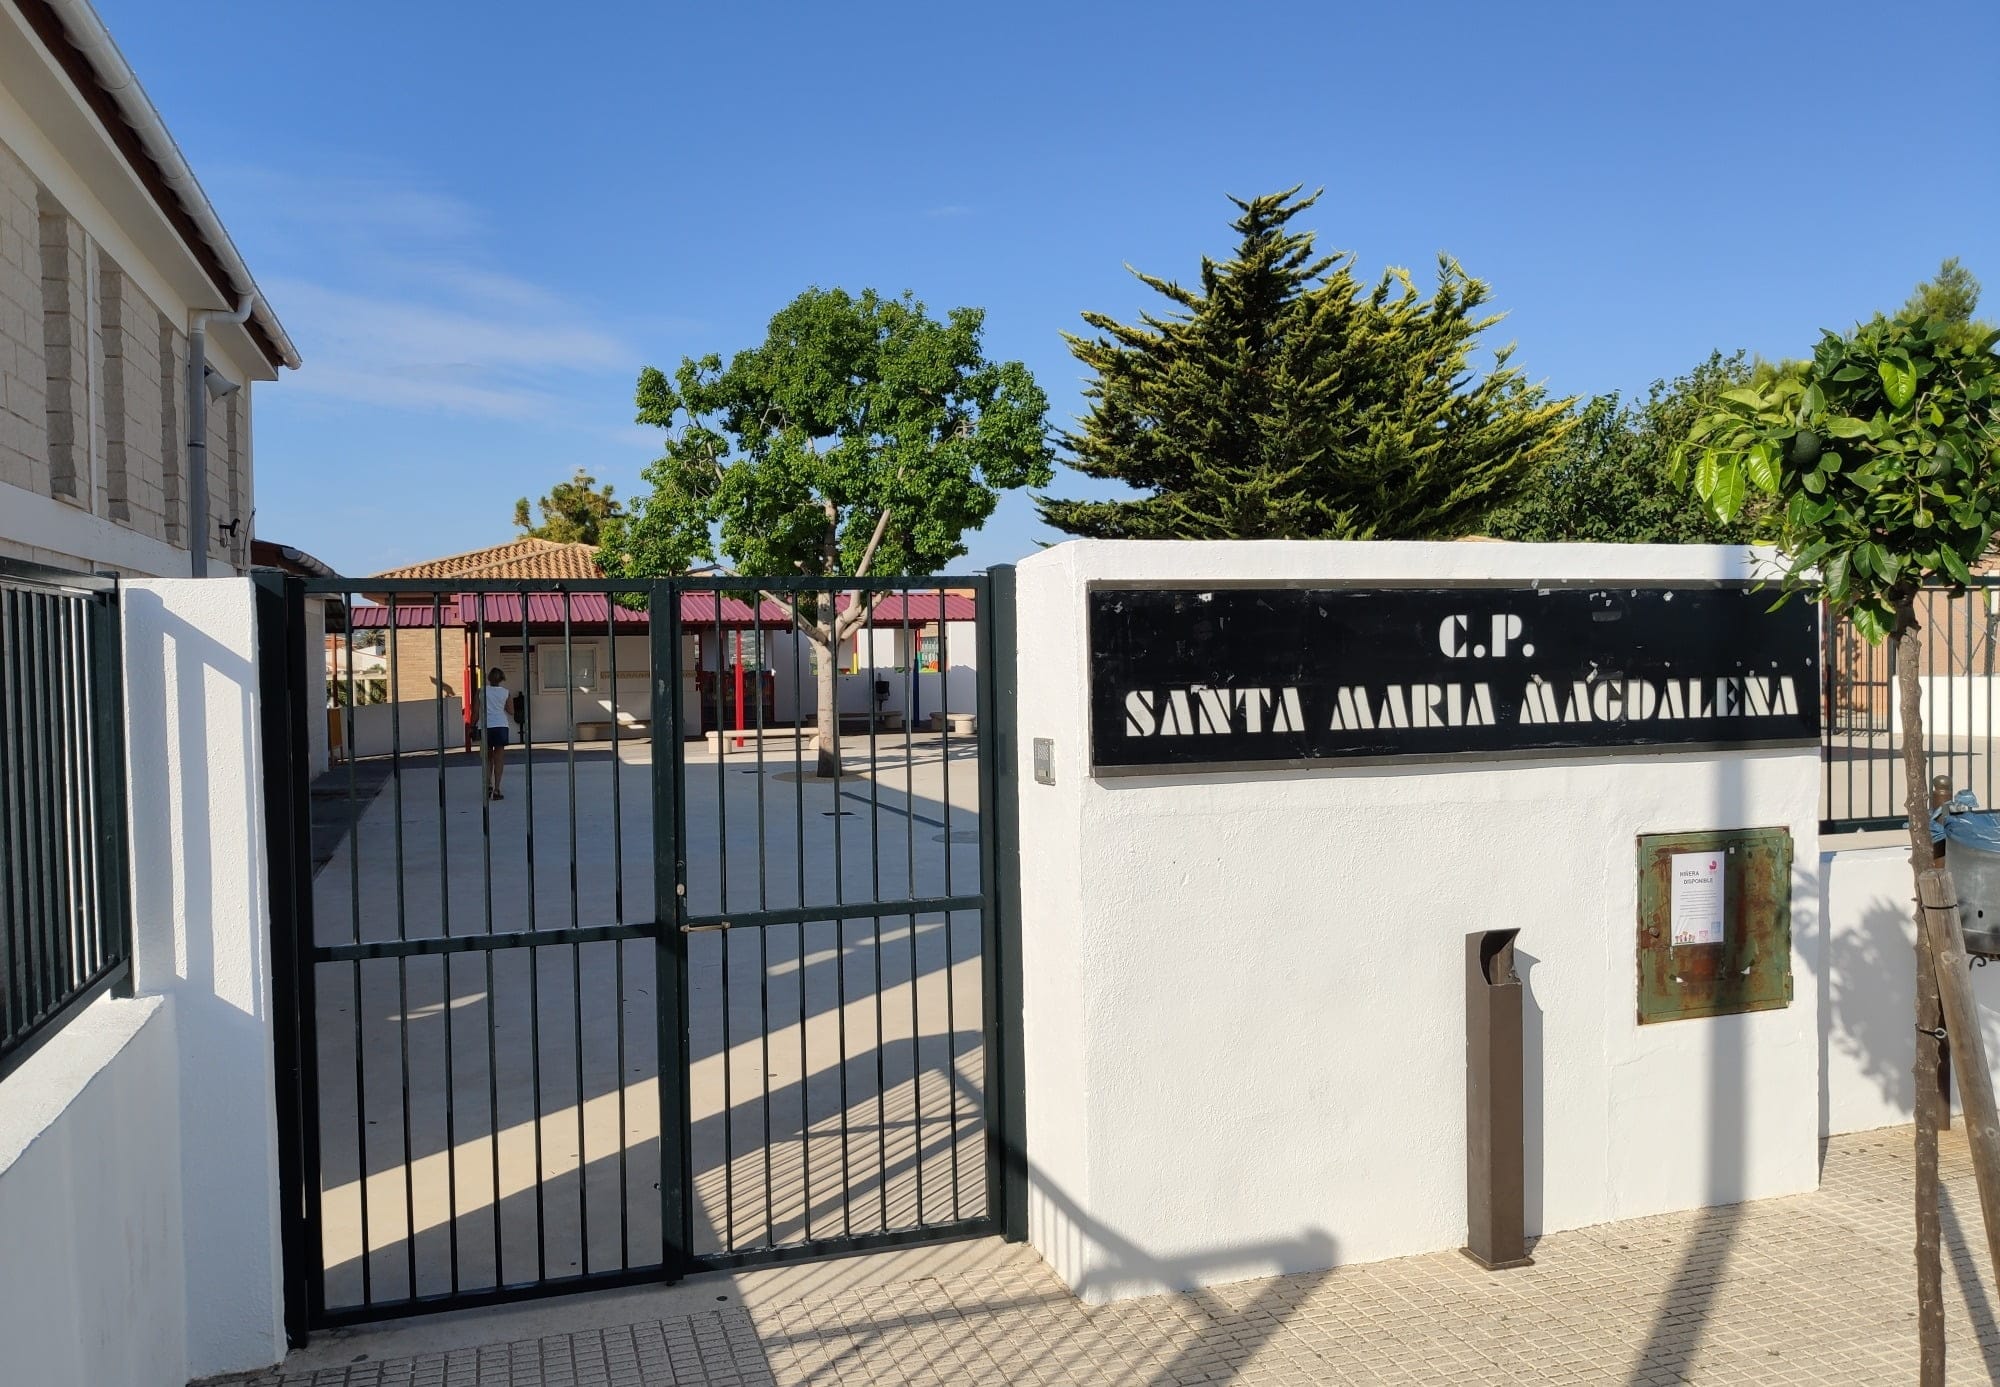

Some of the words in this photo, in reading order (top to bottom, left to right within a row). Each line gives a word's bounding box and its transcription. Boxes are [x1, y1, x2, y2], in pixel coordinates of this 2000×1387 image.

[1439, 614, 1535, 658] C.P.
[1125, 687, 1305, 736] SANTA
[1330, 683, 1496, 730] MARIA
[1519, 676, 1799, 723] MAGDALENA
